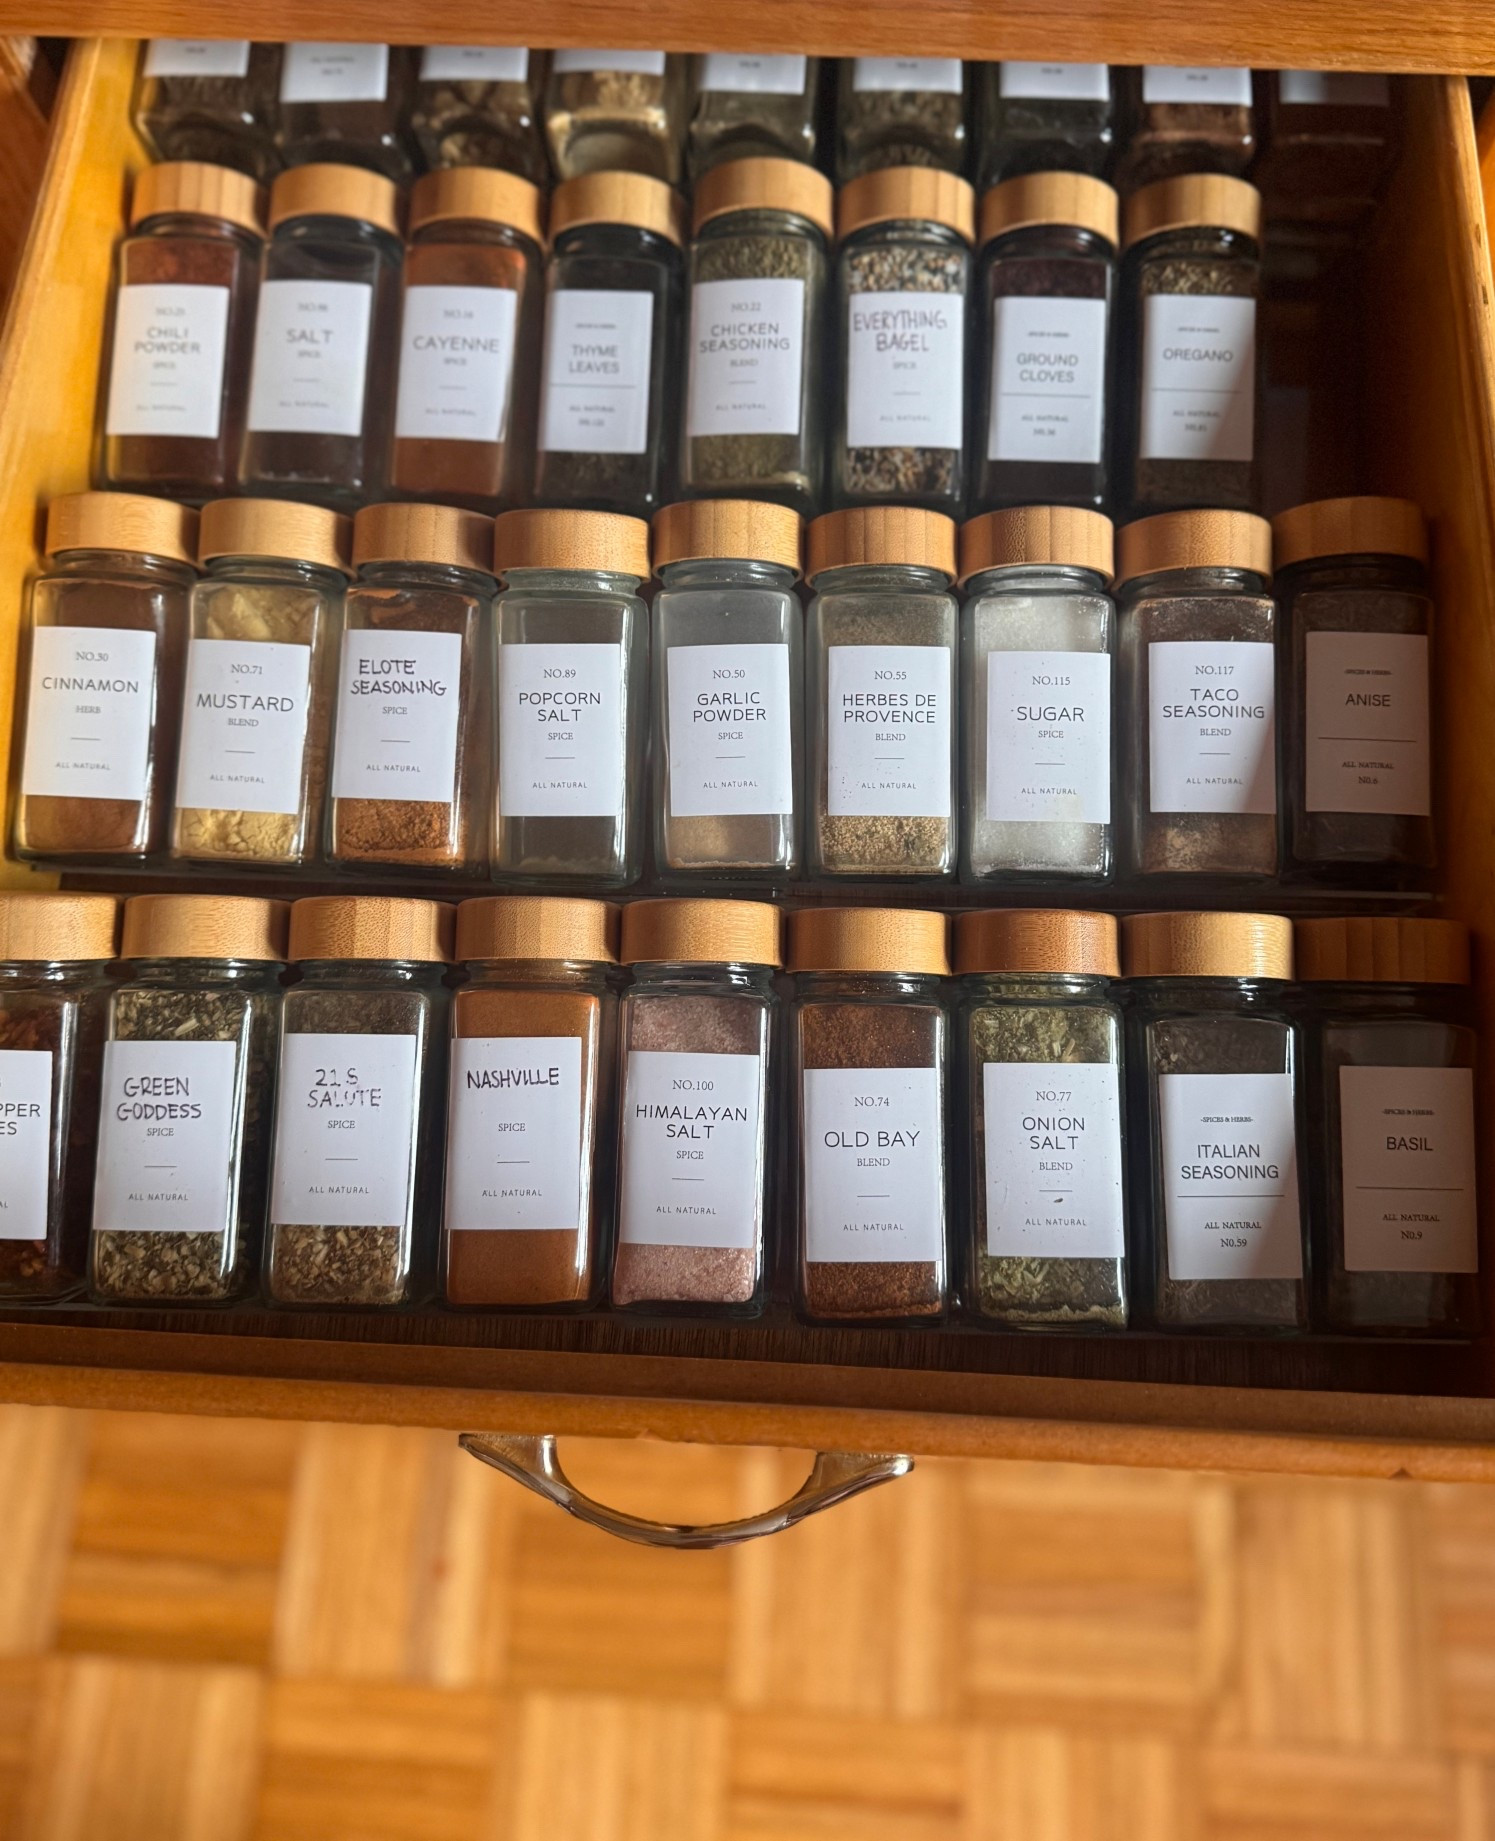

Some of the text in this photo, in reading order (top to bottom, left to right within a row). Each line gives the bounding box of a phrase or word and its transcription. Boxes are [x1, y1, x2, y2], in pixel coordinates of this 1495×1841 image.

[854, 310, 947, 333] EVERYTHING
[146, 326, 188, 339] CHILI
[287, 329, 333, 344] SALT
[711, 323, 779, 337] CHICKEN
[134, 341, 200, 354] POWDER
[413, 336, 498, 353] CAYENNE
[700, 338, 790, 353] SEASONING
[876, 332, 928, 352] BAGEL
[573, 344, 617, 357] THYME
[1163, 348, 1233, 362] OREGANO
[1016, 353, 1079, 366] GROUND
[569, 361, 619, 374] LEAVES
[1019, 369, 1074, 383] CLOVES
[76, 652, 109, 661] NO.30
[231, 664, 262, 674] NO.71
[359, 659, 416, 675] ELOTE
[544, 669, 576, 678] NO.89
[1195, 666, 1234, 675] NO.117
[713, 670, 745, 678] NO.50
[875, 671, 906, 680] NO.55
[1033, 676, 1070, 685] NO.115
[42, 677, 138, 693] CINNAMON
[351, 680, 447, 696] SEASONING
[519, 692, 600, 705] POPCORN
[698, 692, 760, 705] GARLIC
[843, 694, 936, 706] HERBES DE
[1190, 689, 1238, 701] TACO
[1345, 694, 1390, 707] ANISE
[197, 694, 294, 712] MUSTARD
[76, 706, 101, 714] HERB
[382, 707, 407, 715] SPICE
[538, 709, 581, 721] SALT
[694, 709, 766, 722] POWDER
[844, 710, 935, 723] PROVENCE
[1017, 707, 1084, 721] SUGAR
[1163, 705, 1264, 718] SEASONING
[228, 718, 259, 727] BLEND
[548, 732, 573, 740] SPICE
[718, 732, 743, 740] SPICE
[876, 733, 906, 741] BLEND
[1038, 730, 1064, 738] SPICE
[1200, 728, 1231, 736] BLEND
[467, 1068, 559, 1088] NASHVILLE
[124, 1077, 189, 1097] GREEN
[673, 1080, 713, 1090] NO.100
[308, 1086, 381, 1108] SALUTE
[855, 1097, 889, 1106] NO.74
[1036, 1091, 1071, 1101] NO.77
[117, 1103, 201, 1121] GODDESS
[637, 1105, 747, 1121] HIMALAYAN
[328, 1120, 355, 1128] SPICE
[498, 1123, 525, 1131] SPICE
[1023, 1117, 1084, 1131] ONION
[147, 1128, 174, 1136] SPICE
[667, 1124, 714, 1138] SALT
[825, 1131, 920, 1147] OLD BAY
[1030, 1136, 1078, 1149] SALT
[1387, 1137, 1433, 1151] BASIL
[677, 1151, 703, 1159] SPICE
[1198, 1145, 1260, 1158] ITALIAN
[857, 1158, 890, 1166] BLEND
[1040, 1162, 1073, 1170] BLEND
[1182, 1165, 1278, 1179] SEASONING
[501, 1189, 542, 1197] NATURAL
[1046, 1218, 1086, 1226] NATURAL
[1401, 1214, 1440, 1222] NATURAL
